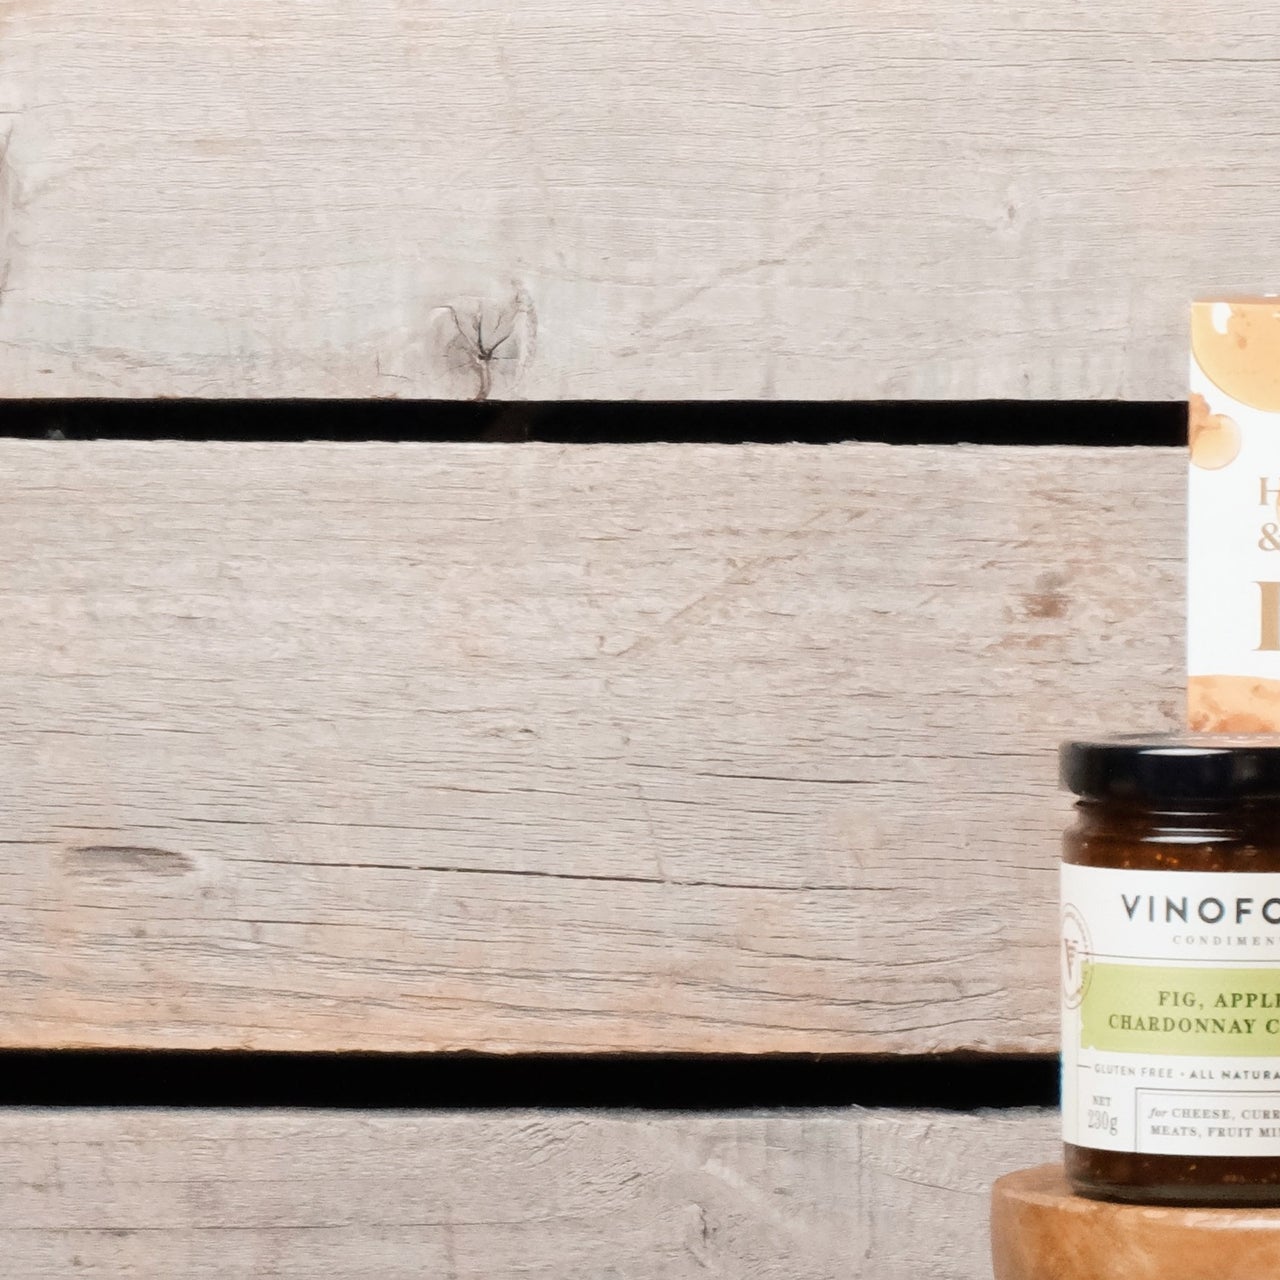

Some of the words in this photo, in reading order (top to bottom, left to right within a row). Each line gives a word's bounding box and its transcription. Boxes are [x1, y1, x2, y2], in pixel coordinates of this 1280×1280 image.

[1158, 990, 1204, 1010] FIG,
[1108, 1013, 1255, 1035] CHARDONNAY
[1094, 1063, 1135, 1077] GLUTEN
[1140, 1067, 1173, 1079] FREE
[1189, 1069, 1215, 1080] ALL
[1093, 1095, 1111, 1107] NET
[1148, 1107, 1168, 1119] for
[1171, 1108, 1236, 1121] CHEESE,
[1150, 1125, 1202, 1138] MEATS,
[1208, 1127, 1253, 1138] FRUIT
